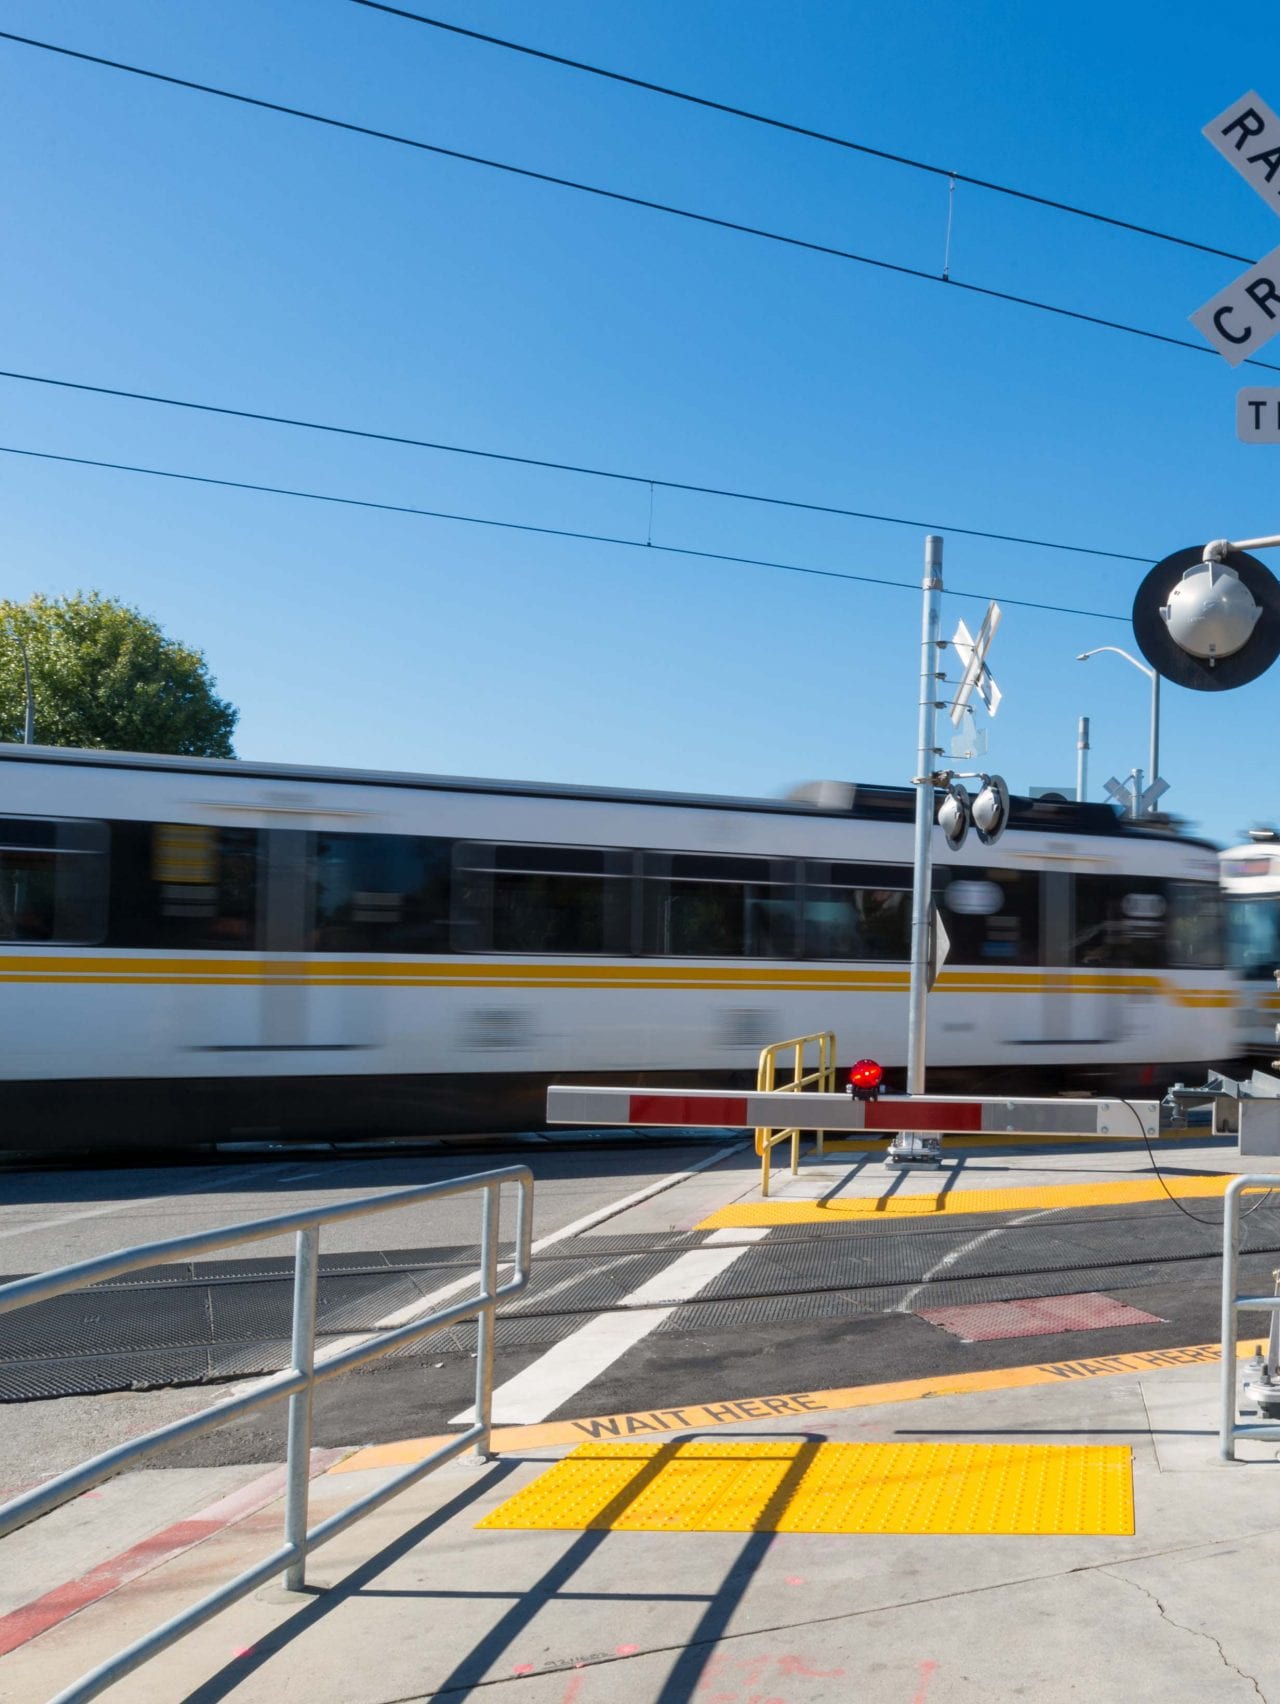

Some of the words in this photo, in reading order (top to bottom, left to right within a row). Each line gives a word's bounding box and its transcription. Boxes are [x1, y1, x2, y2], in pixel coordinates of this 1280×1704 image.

[1036, 1357, 1138, 1379] WAIT
[571, 1409, 692, 1438] WAIT
[702, 1395, 828, 1422] HERE
